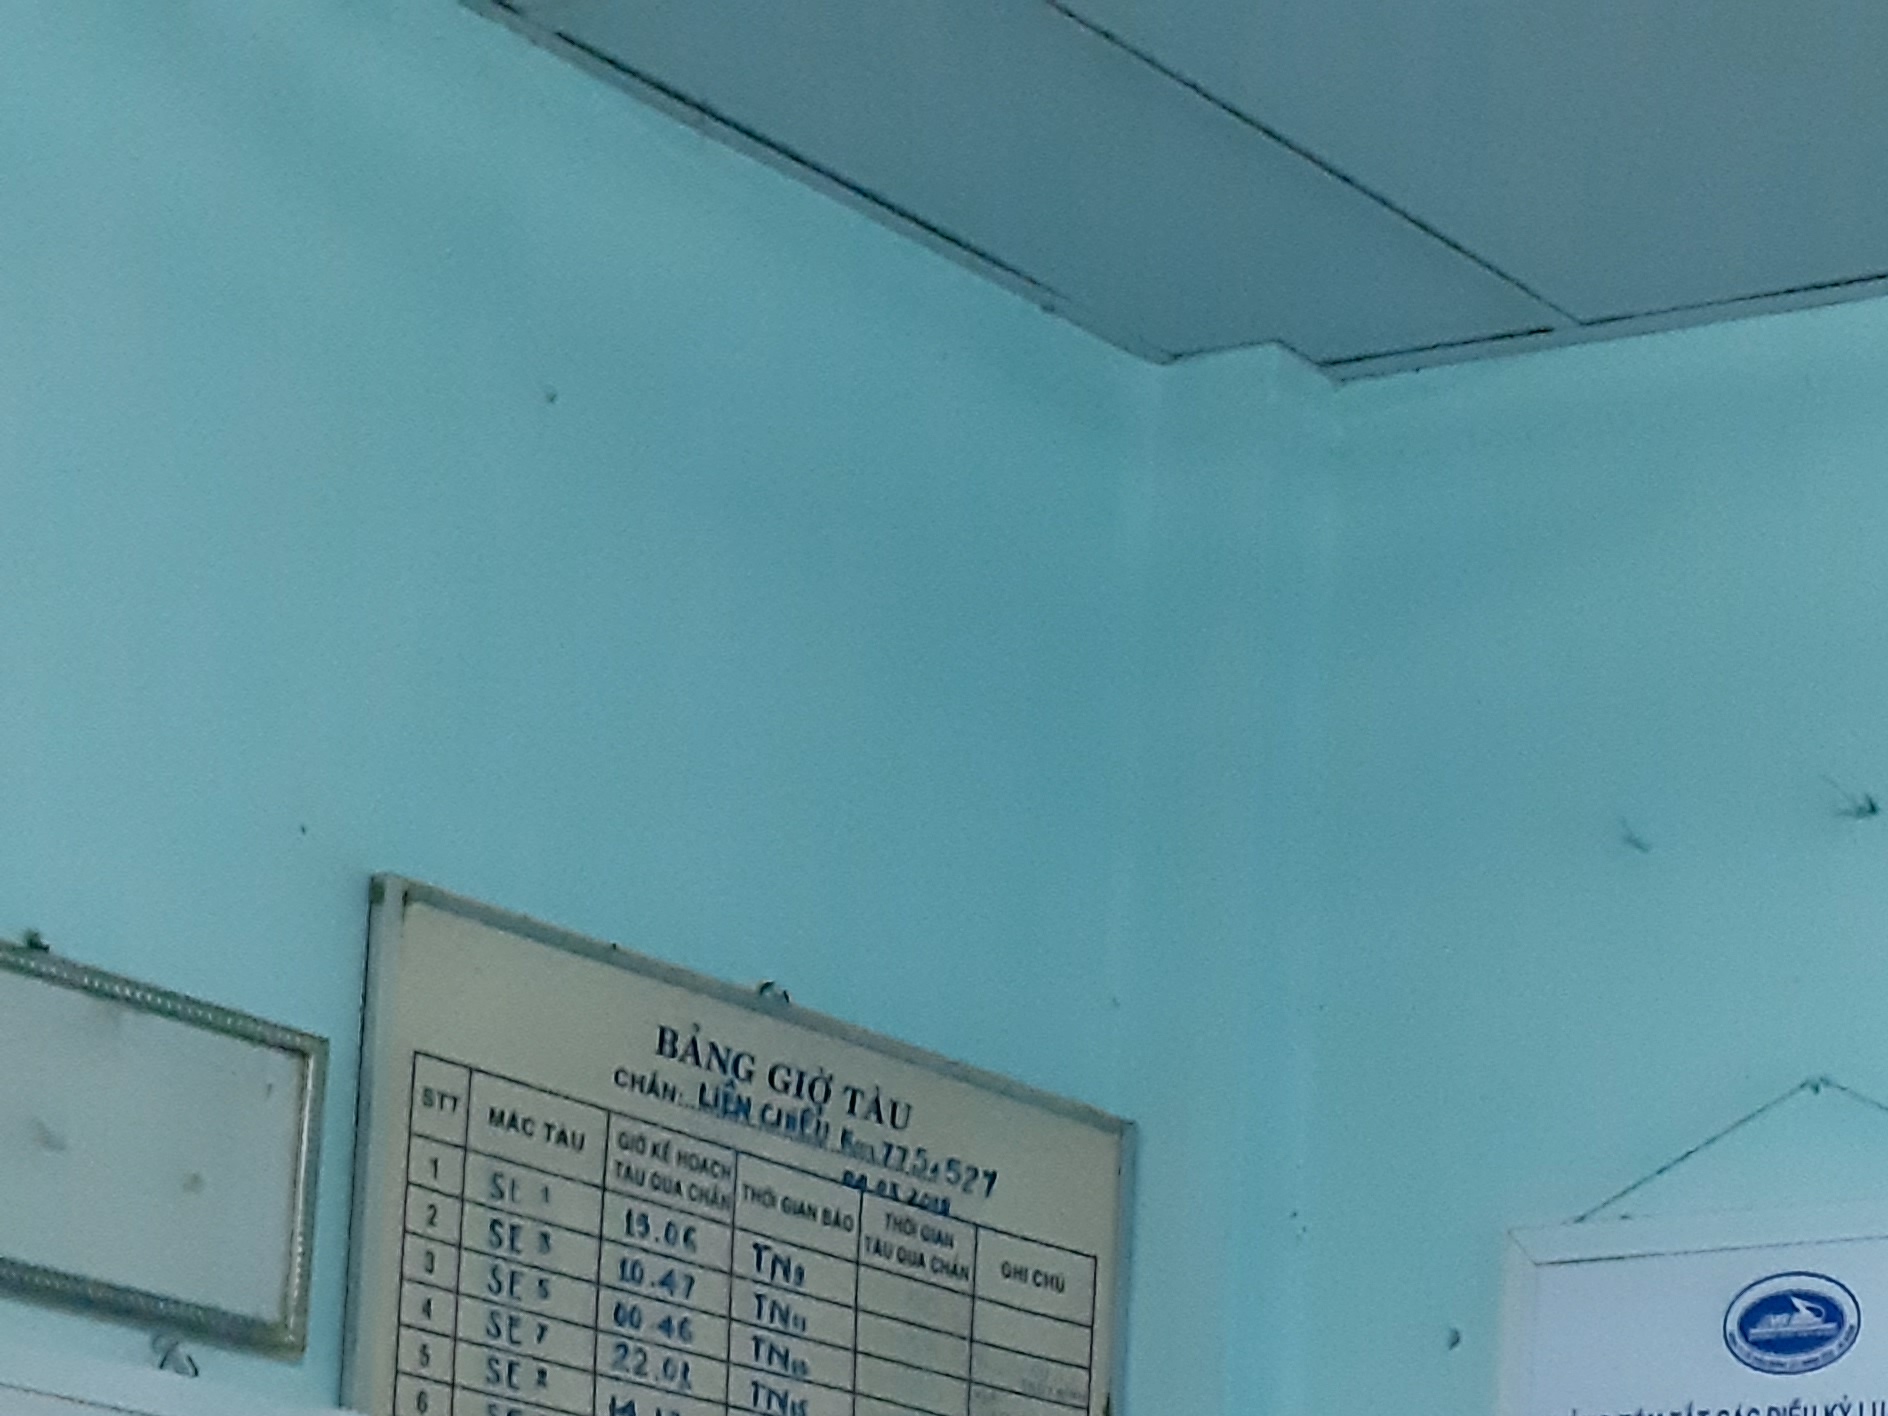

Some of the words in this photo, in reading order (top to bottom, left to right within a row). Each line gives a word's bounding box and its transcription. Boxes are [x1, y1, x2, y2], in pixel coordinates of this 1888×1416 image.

[655, 1023, 756, 1084] BẢNG
[767, 1062, 834, 1105] GIỜ
[842, 1086, 913, 1130] TÀU
[421, 1087, 458, 1114] STT
[544, 1122, 586, 1151] TÀU
